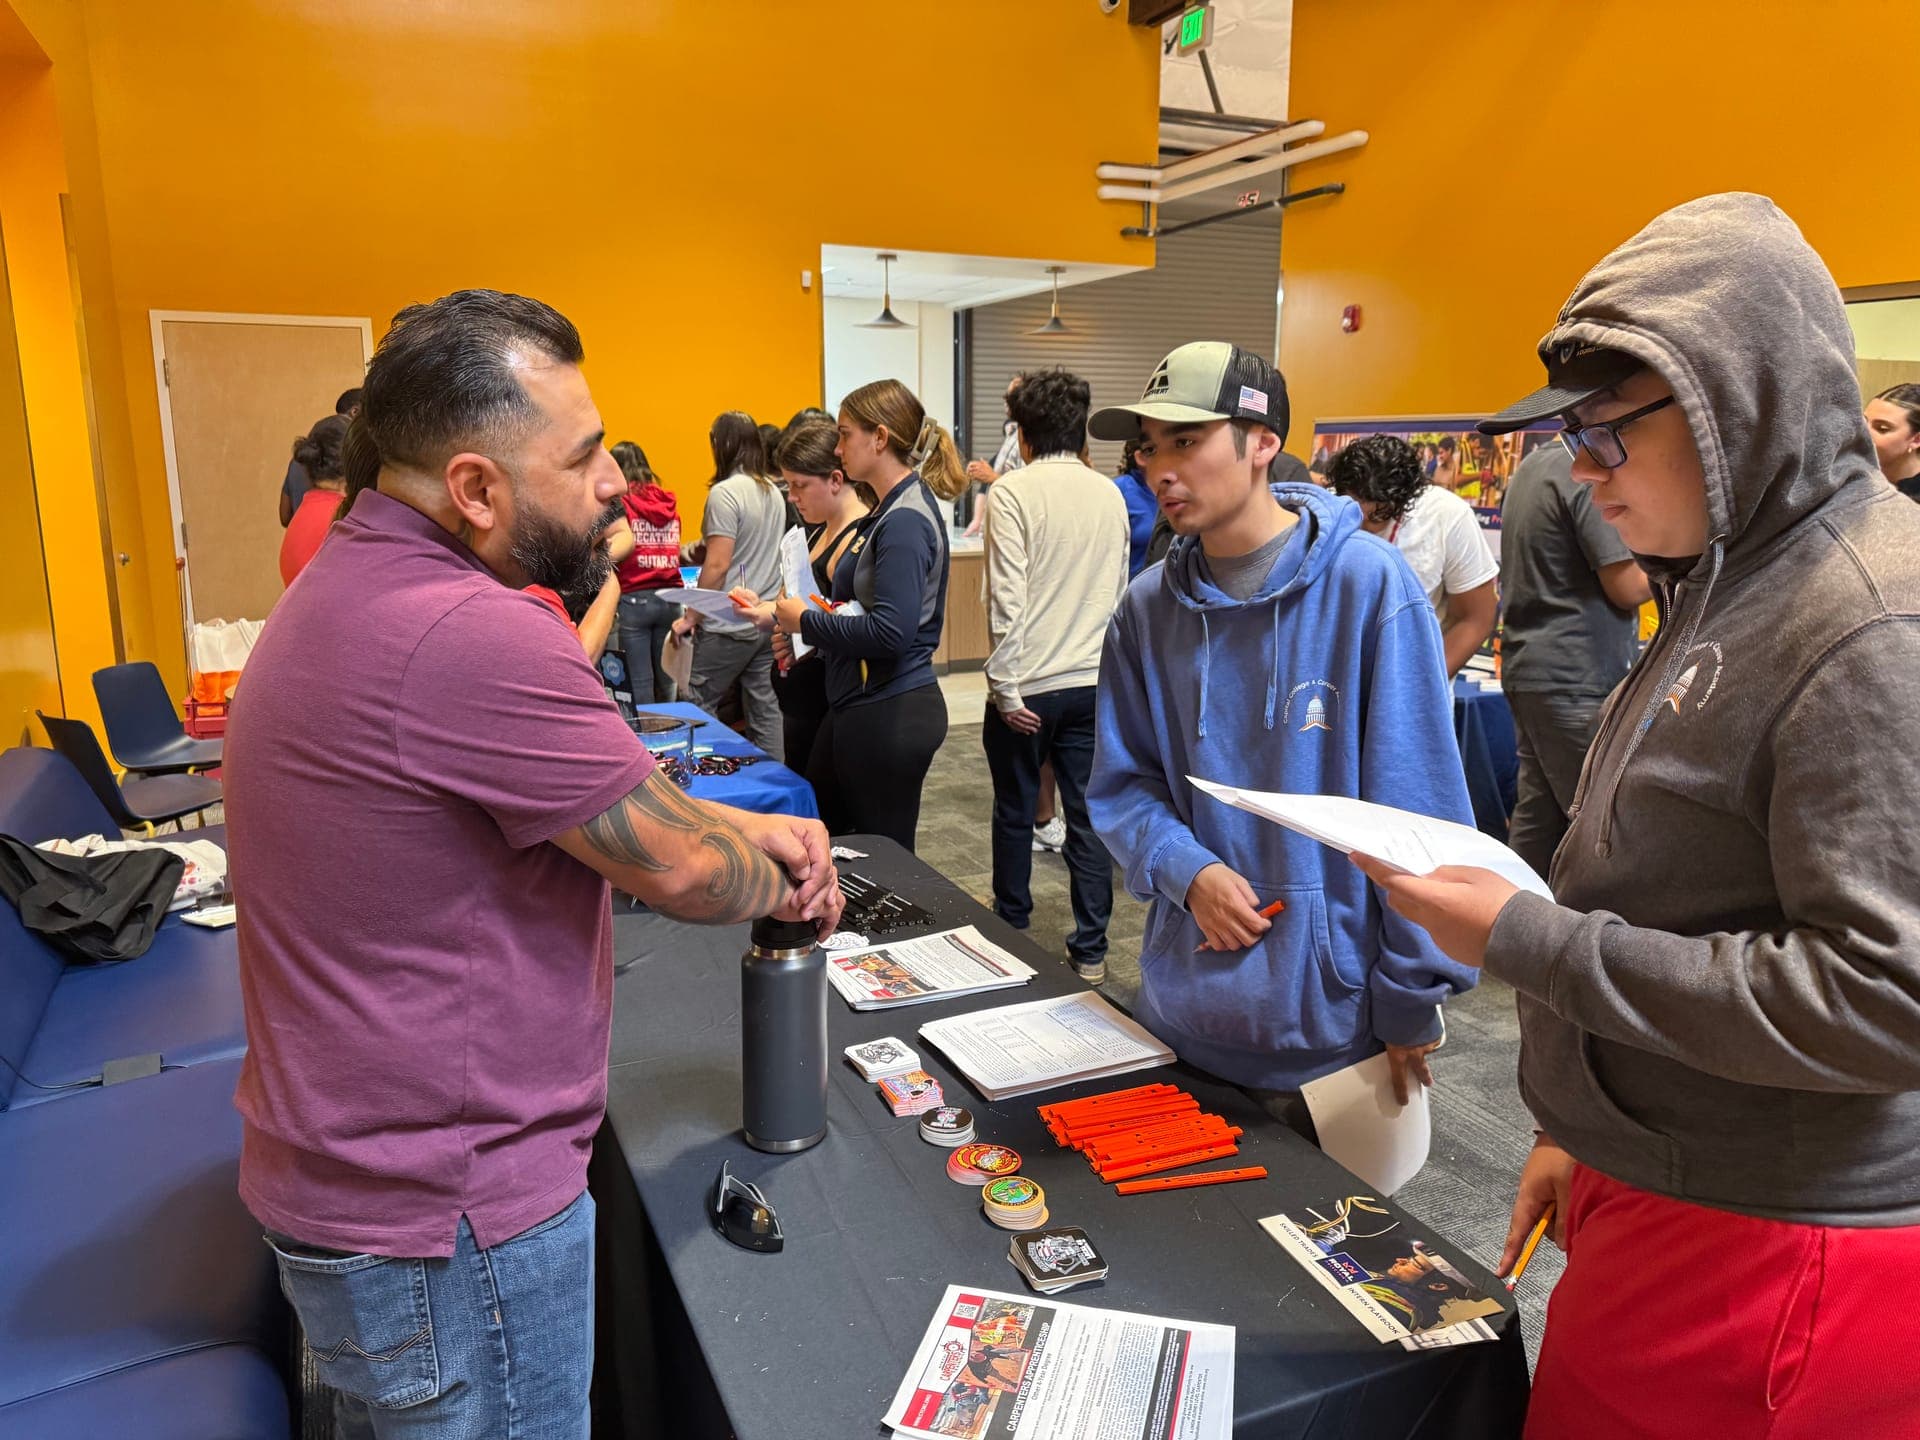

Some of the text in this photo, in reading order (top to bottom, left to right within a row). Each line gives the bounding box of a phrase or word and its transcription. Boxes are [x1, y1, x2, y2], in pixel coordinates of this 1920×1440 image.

[1280, 1222, 1319, 1258] SKILLED TRADES
[1328, 1258, 1354, 1282] ROYAL
[1348, 1287, 1400, 1334] INTERN PLAYBOOK
[1006, 1322, 1051, 1432] CARPENTERS APPRENTICESHIP
